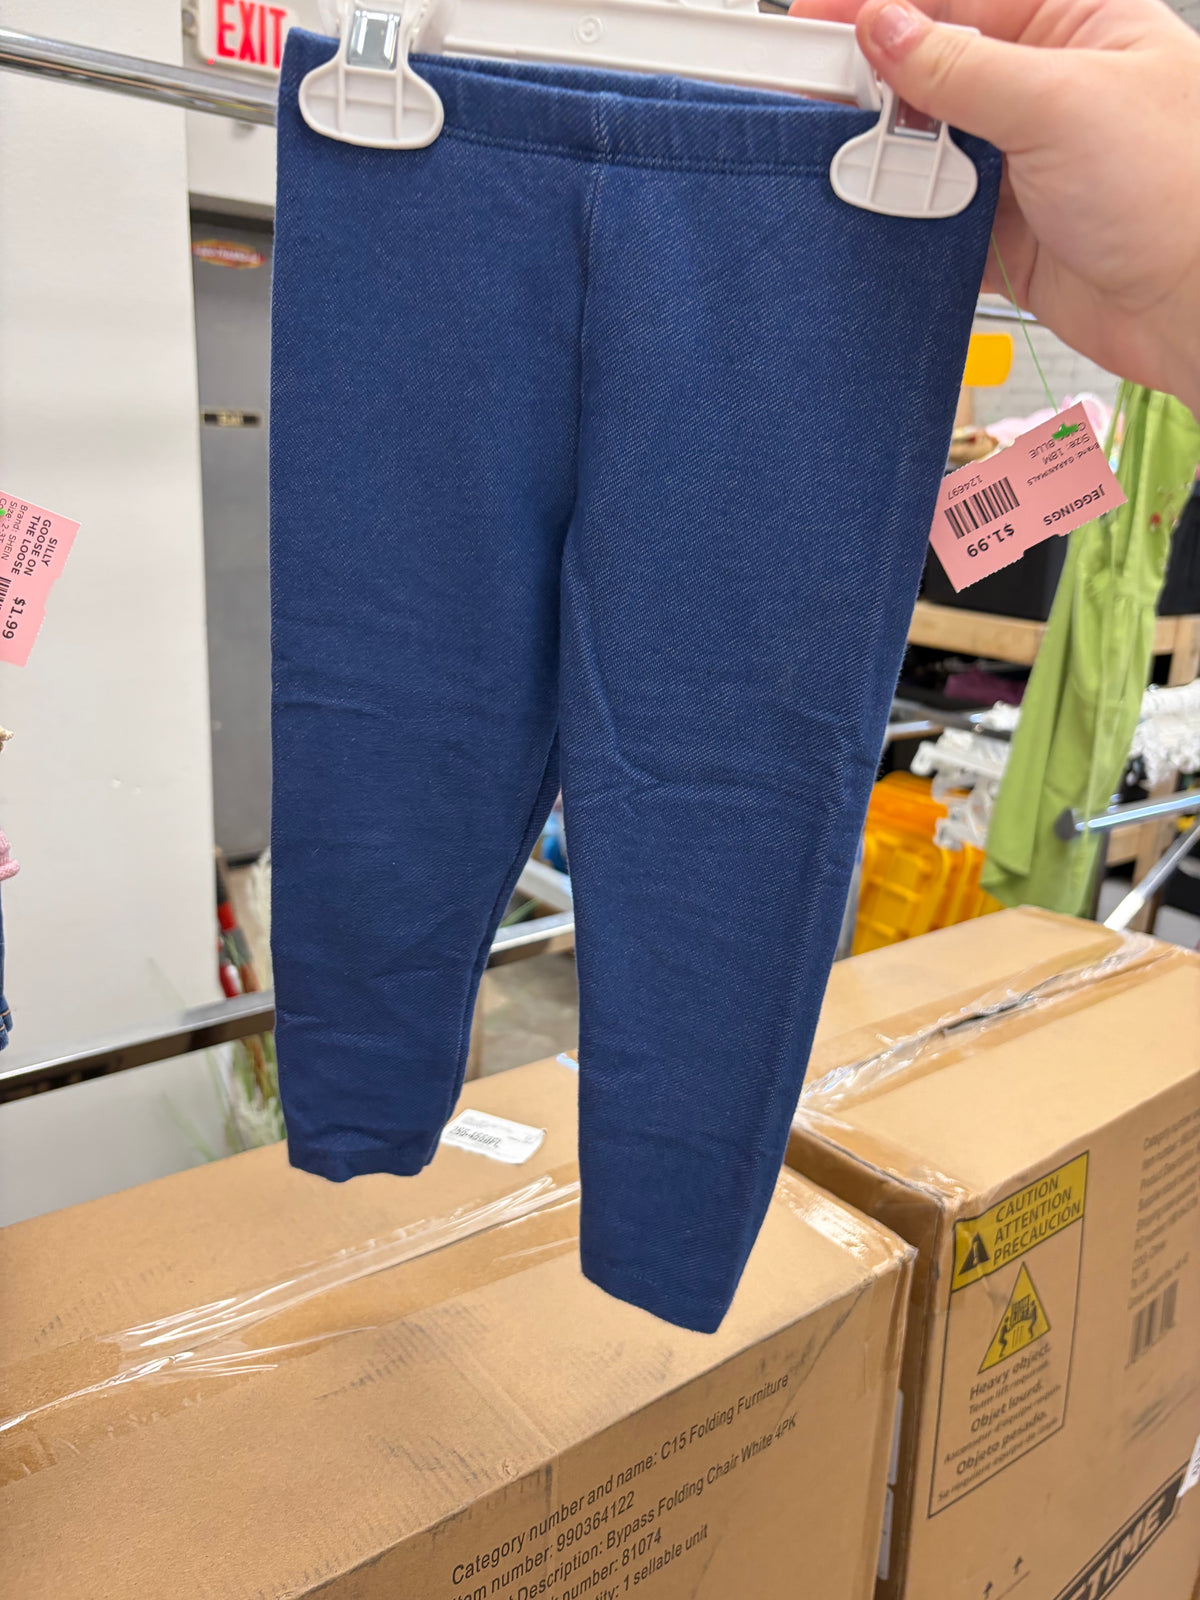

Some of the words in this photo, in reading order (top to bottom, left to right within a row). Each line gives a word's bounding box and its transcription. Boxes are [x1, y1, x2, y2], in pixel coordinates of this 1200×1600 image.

[217, 0, 287, 69] EXIT
[1028, 438, 1056, 459] BLUE
[947, 474, 983, 500] 124697
[1043, 484, 1106, 526] JEGGINGS
[6, 501, 18, 521] Size:
[13, 504, 28, 533] Brand:
[26, 515, 41, 537] THE
[1, 534, 16, 561] SHEIN
[11, 538, 31, 575] LOOSE
[31, 519, 52, 557] GOOSE
[41, 536, 58, 567] SILLY
[966, 523, 1015, 557] $1.99
[24, 558, 36, 576] ON
[2, 597, 26, 639] $1.99
[994, 1187, 1072, 1245] ATTENTION
[996, 1175, 1059, 1222] CAUTION
[970, 1369, 1010, 1400] Heavy
[971, 1403, 1007, 1432] Objet
[957, 1442, 1000, 1475] Objeto
[451, 1531, 526, 1585] Category
[529, 1495, 585, 1542] number
[587, 1474, 613, 1505] and
[616, 1452, 657, 1488] name:
[660, 1432, 687, 1460] C15
[689, 1406, 734, 1444] Folding
[737, 1374, 789, 1415] Furniture
[518, 1541, 603, 1600] Description:
[606, 1509, 655, 1550] Bypass
[657, 1478, 704, 1517] Folding
[706, 1453, 739, 1484] Chair
[741, 1432, 774, 1463] White
[774, 1411, 798, 1440] 4PK
[491, 1545, 553, 1594] number:
[557, 1490, 635, 1552] 990364122
[623, 1574, 631, 1592] 1
[633, 1543, 682, 1587] sellable
[685, 1523, 708, 1551] unit
[1070, 1495, 1166, 1600] TIME
[562, 1558, 619, 1600] number:
[621, 1527, 662, 1566] 81074
